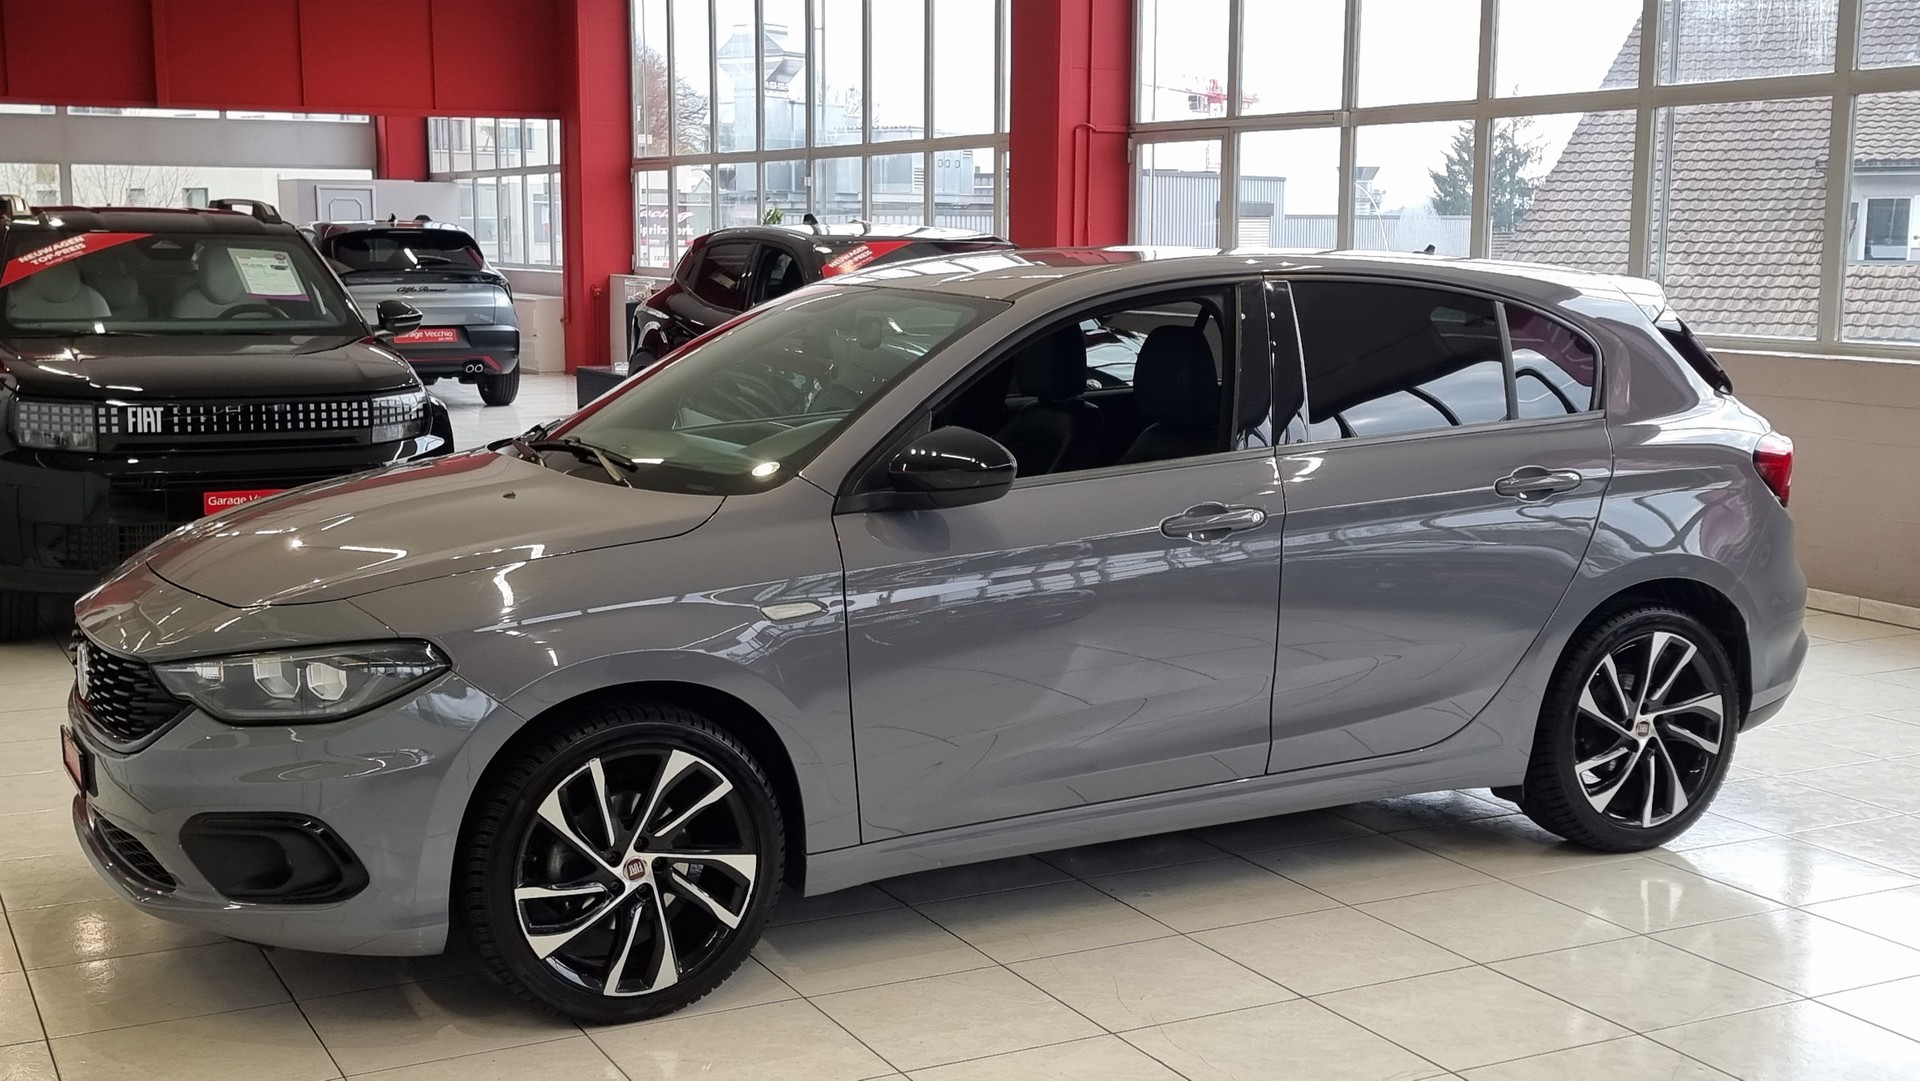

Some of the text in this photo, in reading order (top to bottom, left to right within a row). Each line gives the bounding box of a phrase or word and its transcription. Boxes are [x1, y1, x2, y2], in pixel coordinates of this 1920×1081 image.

[18, 235, 85, 263] NEUWAGEN
[29, 243, 87, 265] TOP-PREIS
[128, 407, 164, 433] FIAT
